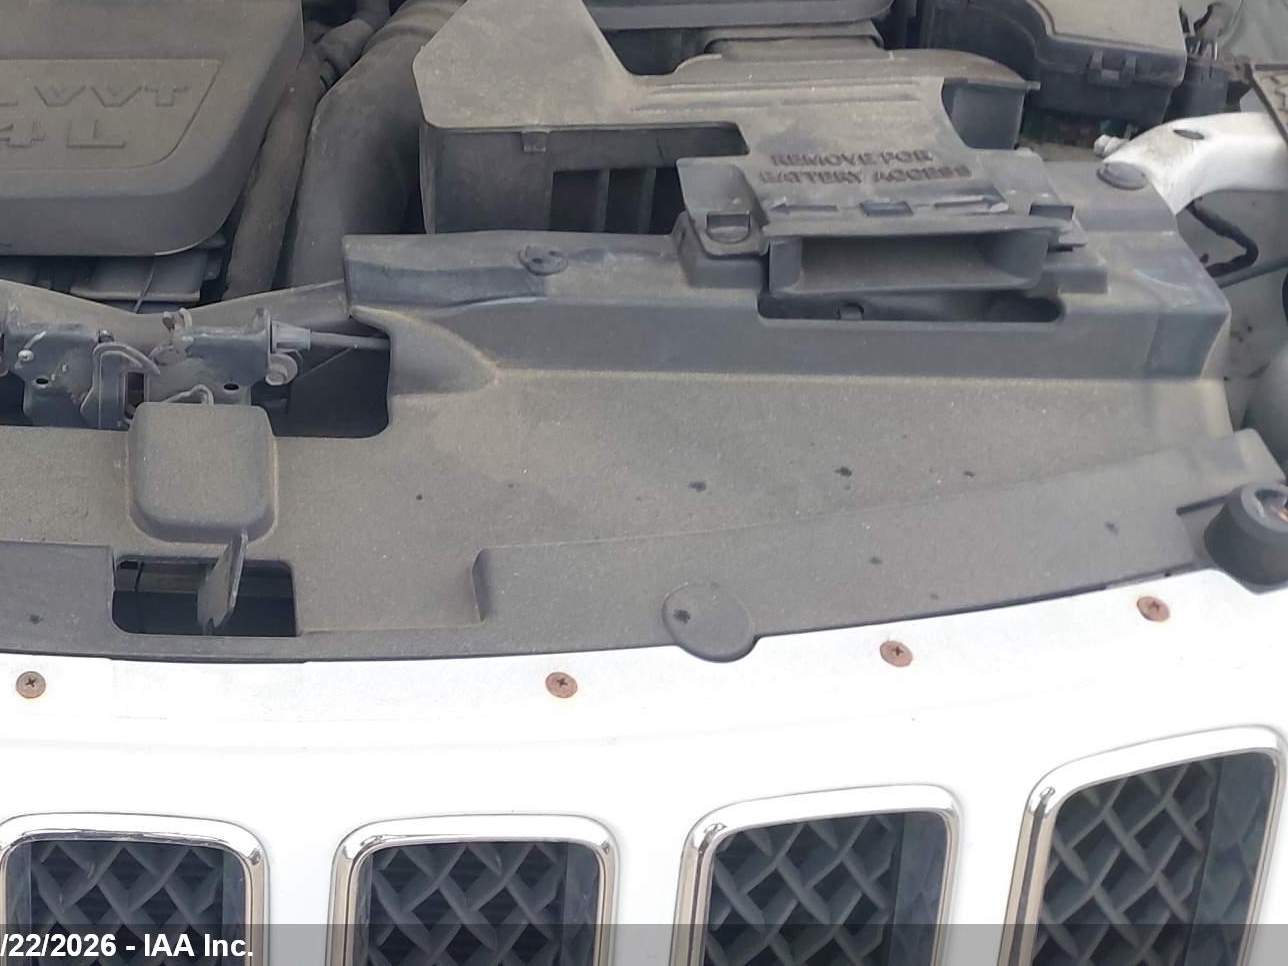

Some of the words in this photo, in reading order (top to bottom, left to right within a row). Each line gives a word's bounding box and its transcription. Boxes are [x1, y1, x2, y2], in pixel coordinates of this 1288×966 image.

[31, 84, 191, 107] VVT
[769, 152, 877, 168] REMOVE
[879, 150, 934, 164] FOR
[758, 170, 863, 185] BATTERY
[872, 165, 972, 183] ACCESS
